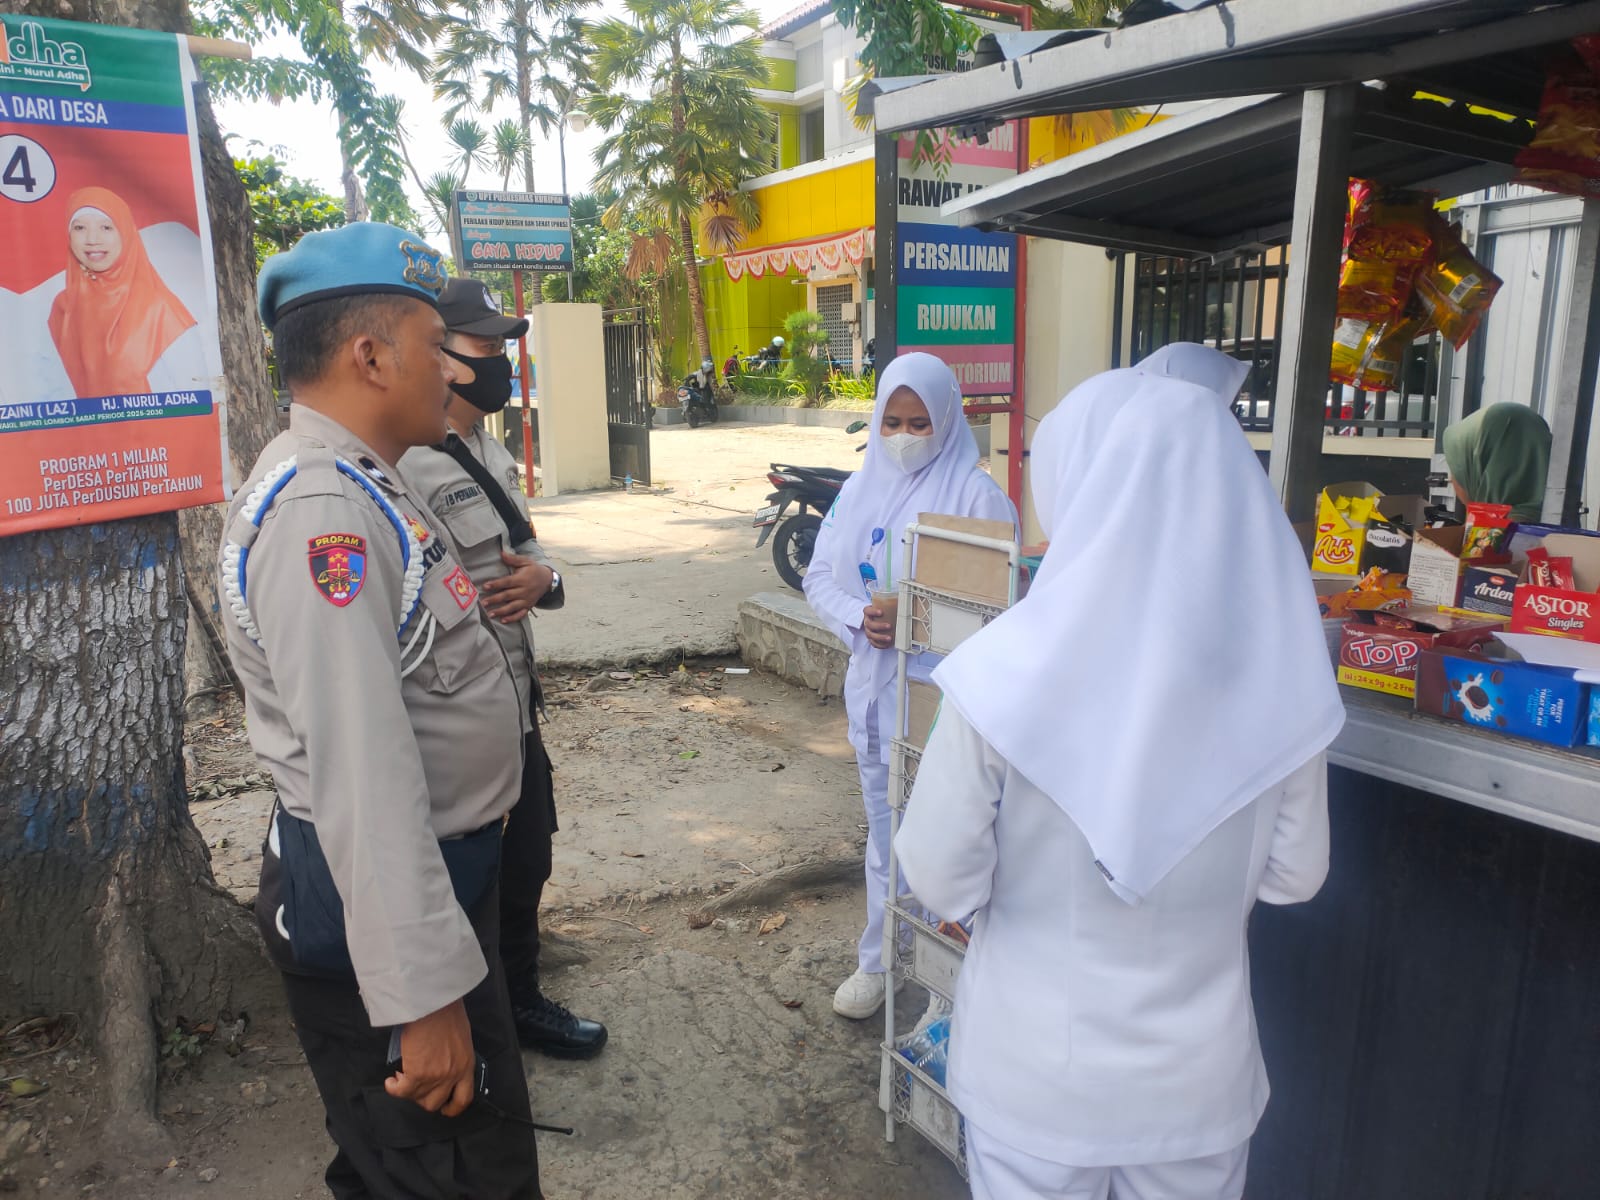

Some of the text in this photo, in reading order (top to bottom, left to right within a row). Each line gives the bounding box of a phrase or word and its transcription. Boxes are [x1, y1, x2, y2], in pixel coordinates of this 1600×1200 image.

[0, 63, 15, 74] ini
[24, 67, 54, 78] Nurul
[57, 70, 85, 81] Adha
[12, 95, 56, 120] DARI
[61, 99, 109, 124] DESA
[3, 146, 36, 193] 4
[899, 178, 963, 207] RAWAT
[489, 218, 505, 226] HIDUP
[472, 242, 564, 260] GAYA HIDUP
[903, 241, 1010, 273] PERSALINAN
[917, 303, 996, 331] RUJUKAN
[0, 405, 33, 420] ZAINI
[102, 392, 198, 411] HJ. NURUL ADHA
[20, 419, 42, 428] BUPATI
[44, 416, 74, 426] LOMBOK
[76, 414, 96, 423] BARAT
[97, 411, 125, 421] PERIODE
[39, 447, 168, 476] PROGRAM 1 MILIAR
[44, 463, 168, 492] PerDESA PerTAHUN
[6, 475, 203, 515] 100 JUTA PerDUSUN PerTAHUN
[315, 535, 360, 547] PROPAM
[1474, 582, 1513, 602] Arden
[1523, 594, 1592, 618] ASTOR
[1547, 616, 1585, 631] Singles
